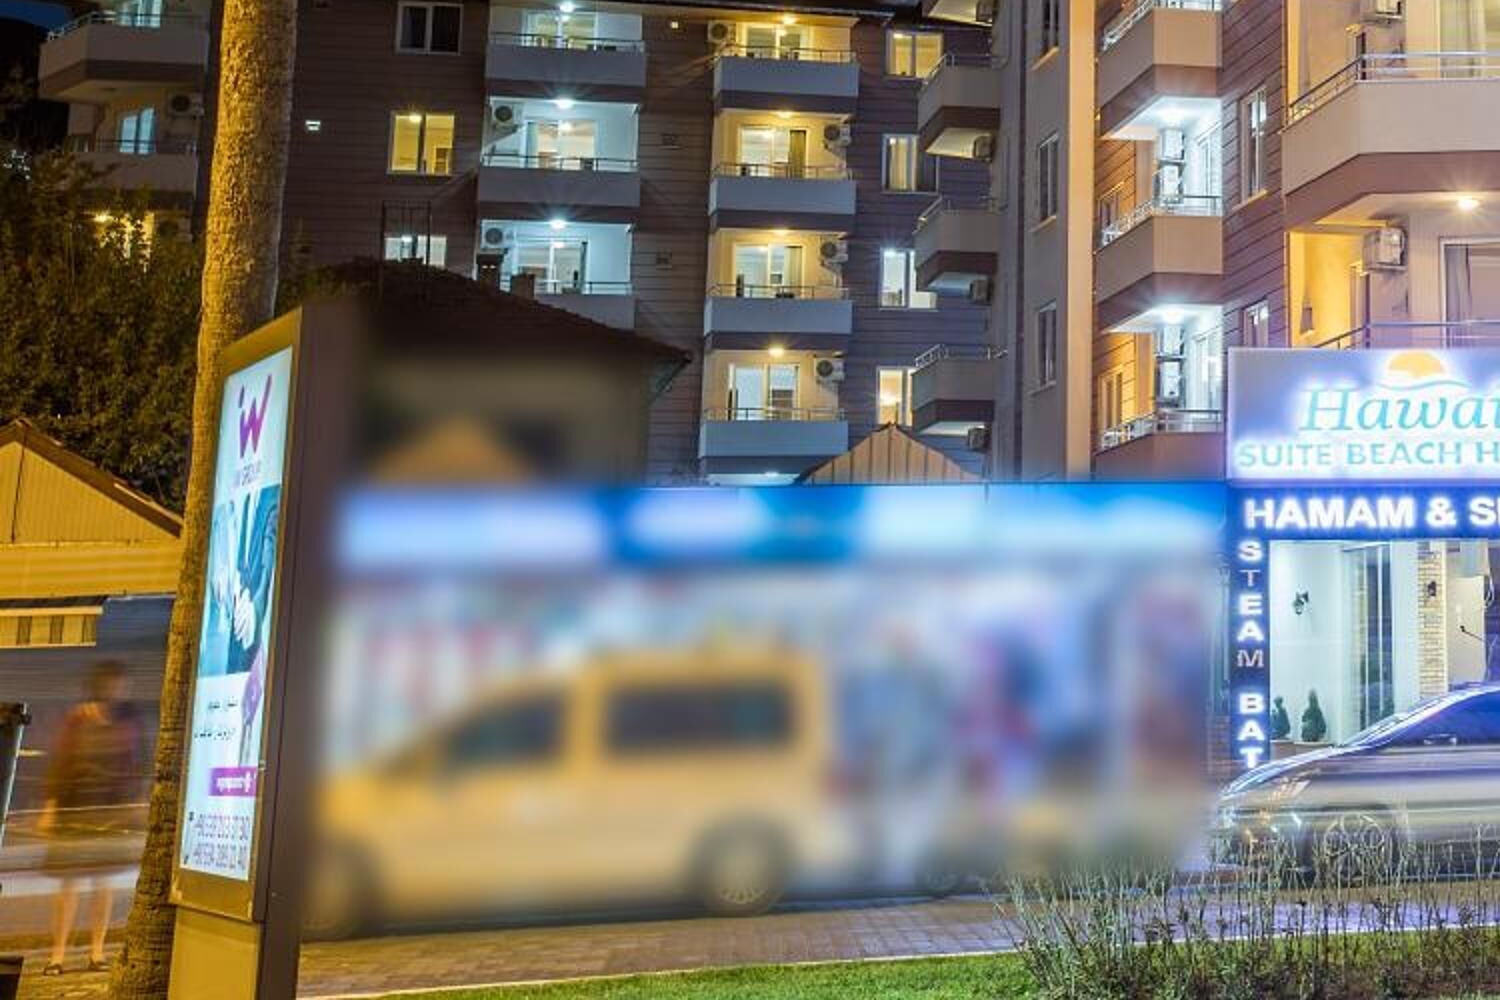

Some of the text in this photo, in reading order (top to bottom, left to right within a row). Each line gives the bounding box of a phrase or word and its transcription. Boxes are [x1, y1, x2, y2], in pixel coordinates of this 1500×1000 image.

[1239, 443, 1332, 467] SUITE
[1346, 441, 1463, 465] BEACH
[1244, 498, 1415, 529] HAMAM
[1425, 497, 1457, 528] &
[1237, 540, 1265, 668] STEAM
